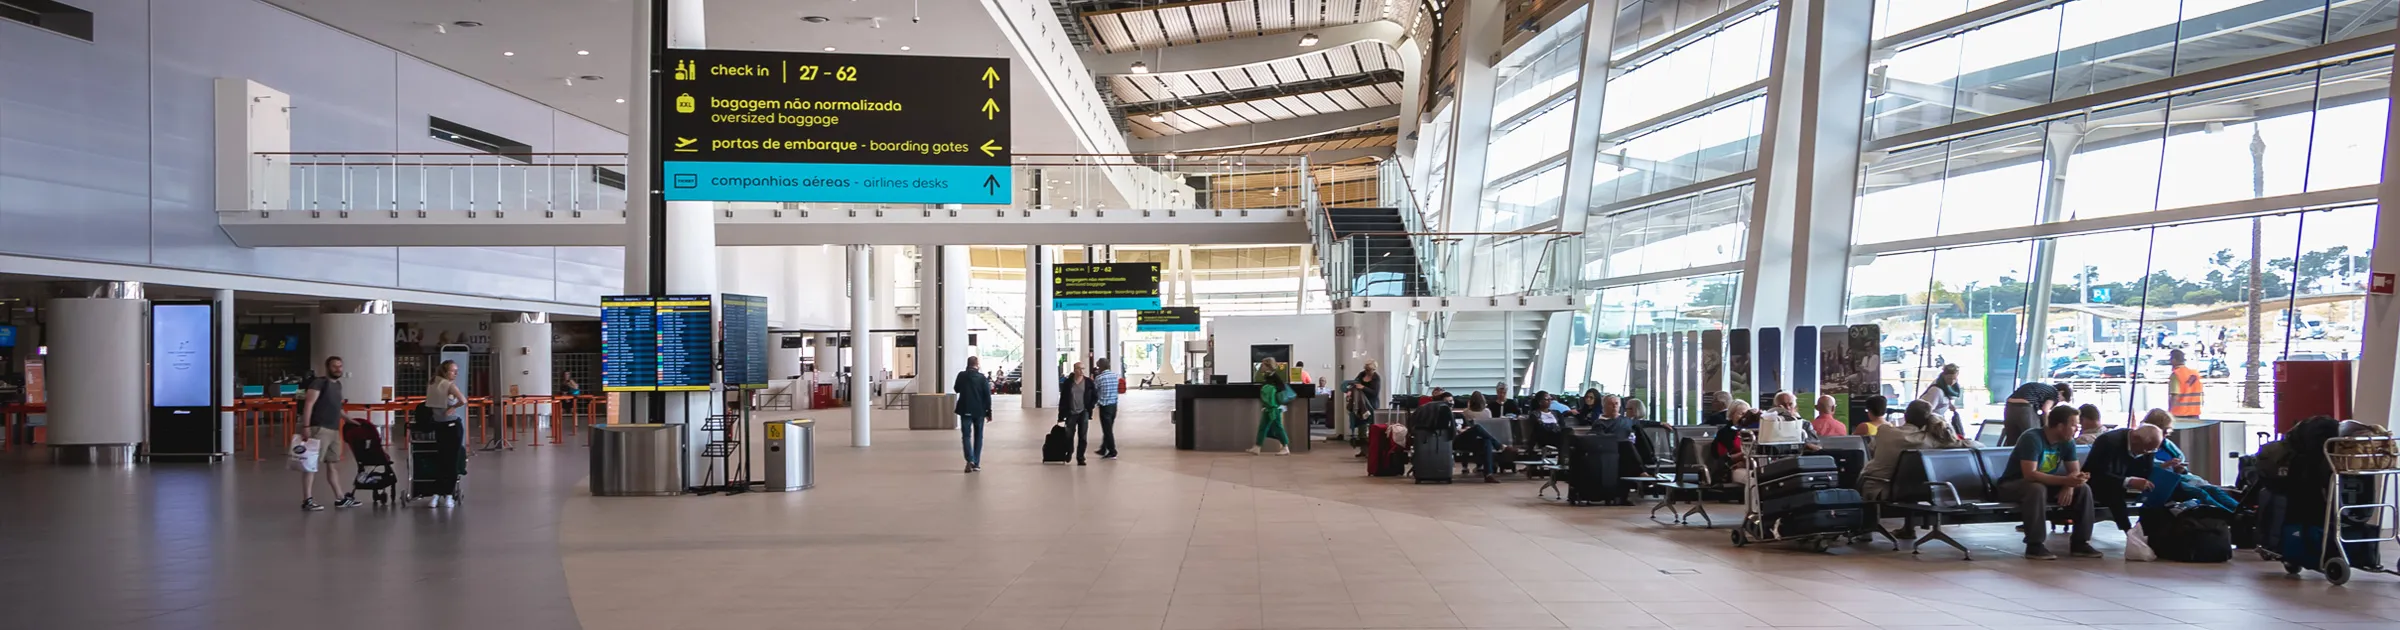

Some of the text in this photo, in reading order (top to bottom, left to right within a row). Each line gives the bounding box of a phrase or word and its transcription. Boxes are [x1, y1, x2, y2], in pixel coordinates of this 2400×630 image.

[711, 64, 753, 76] check
[757, 65, 770, 77] in
[799, 65, 819, 81] 27
[836, 66, 857, 82] 62
[710, 97, 903, 112] bagagem não normalizada
[710, 110, 839, 127] oversized baggage
[711, 137, 759, 151] portas
[762, 138, 781, 150] de
[784, 139, 858, 154] embarque
[869, 140, 929, 155] boarding
[932, 142, 969, 155] gates
[711, 175, 799, 189] companhias
[802, 174, 851, 188] aéreas
[863, 177, 909, 189] airlines
[912, 177, 949, 189] desks
